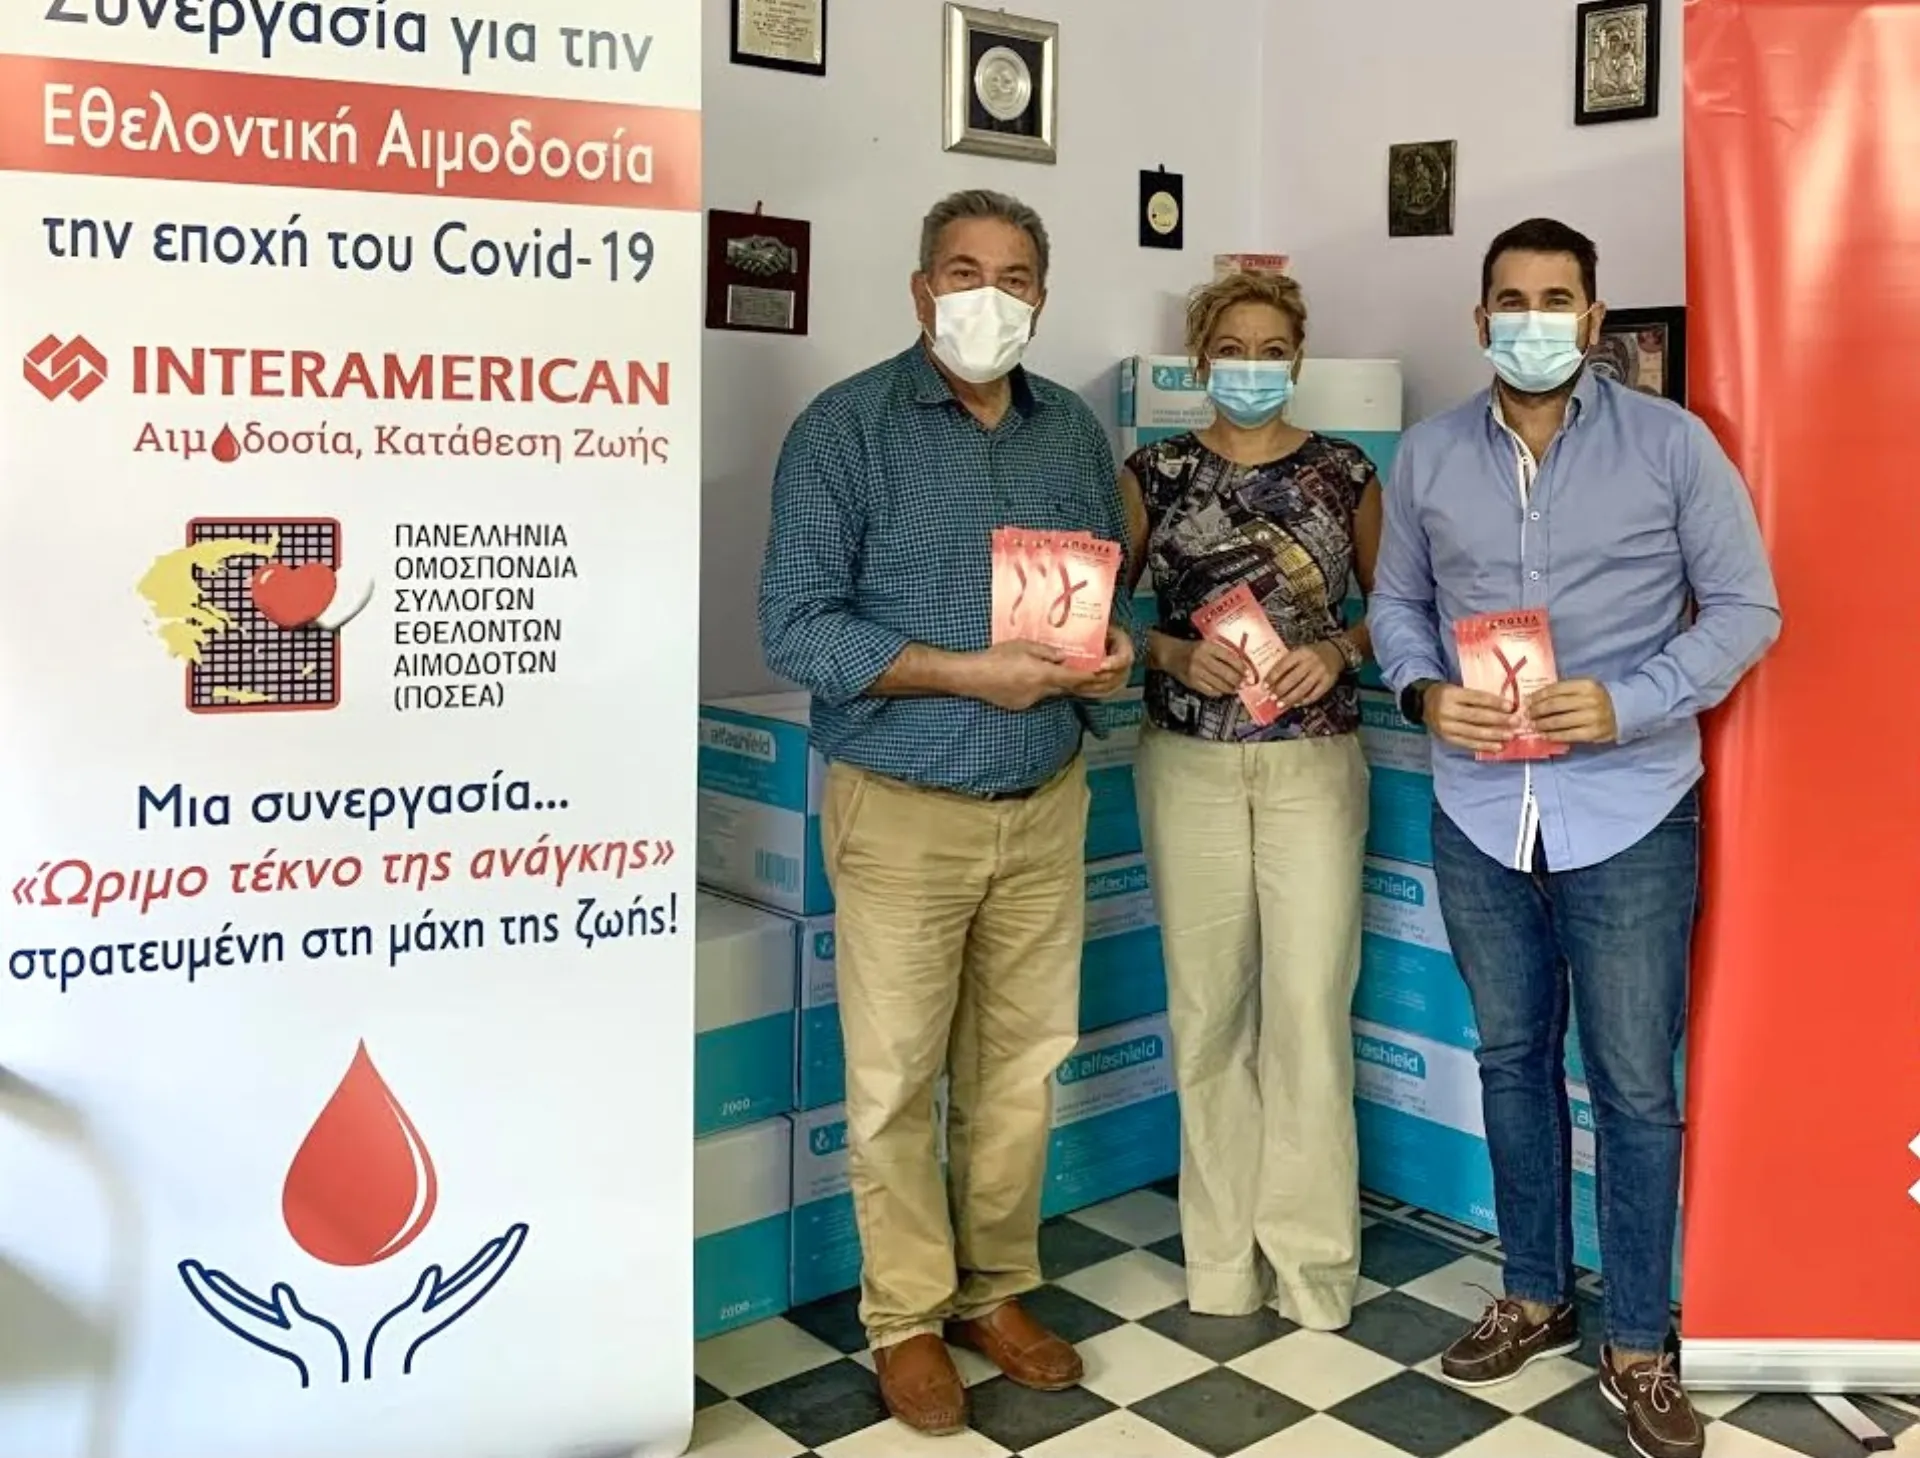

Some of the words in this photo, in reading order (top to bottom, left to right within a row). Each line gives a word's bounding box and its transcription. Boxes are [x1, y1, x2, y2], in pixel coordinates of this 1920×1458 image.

[451, 17, 536, 75] για
[560, 28, 653, 72] την
[42, 82, 358, 165] Εθελοντική
[377, 107, 654, 188] Αιμοδοσία
[43, 218, 134, 259] την
[153, 214, 308, 267] εποχή
[328, 232, 413, 272] του
[433, 221, 655, 283] Covid-19
[132, 345, 670, 405] INTERAMERICAN
[375, 423, 562, 463] Κατάθεση
[574, 427, 669, 464] Ζωής
[395, 524, 568, 548] ΠΑΝΕΛΛΗΝΙΑ
[395, 556, 578, 580] ΟΜΟΣΠΟΝΔΙΑ
[394, 588, 534, 612] ΣΥΛΛΟΓΩΝ
[395, 619, 562, 645] ΕΘΕΛΟΝΤΩΝ
[394, 650, 556, 677] ΑΙΜΟΔΟΤΩΝ
[394, 682, 504, 711] (ΠΟΣΕΑ)
[138, 783, 231, 830] Μια
[252, 770, 569, 831] συνεργασία...
[12, 860, 209, 917] «Ώριμο
[230, 848, 363, 893] τέκνο
[383, 852, 451, 886] της
[470, 834, 675, 886] ανάγκης»
[9, 922, 285, 992] στρατευμένη
[302, 925, 373, 959] στη
[389, 912, 484, 967] μάχη
[501, 911, 559, 945] της
[575, 892, 678, 941] ζωής!
[1081, 1039, 1156, 1077] alfashield
